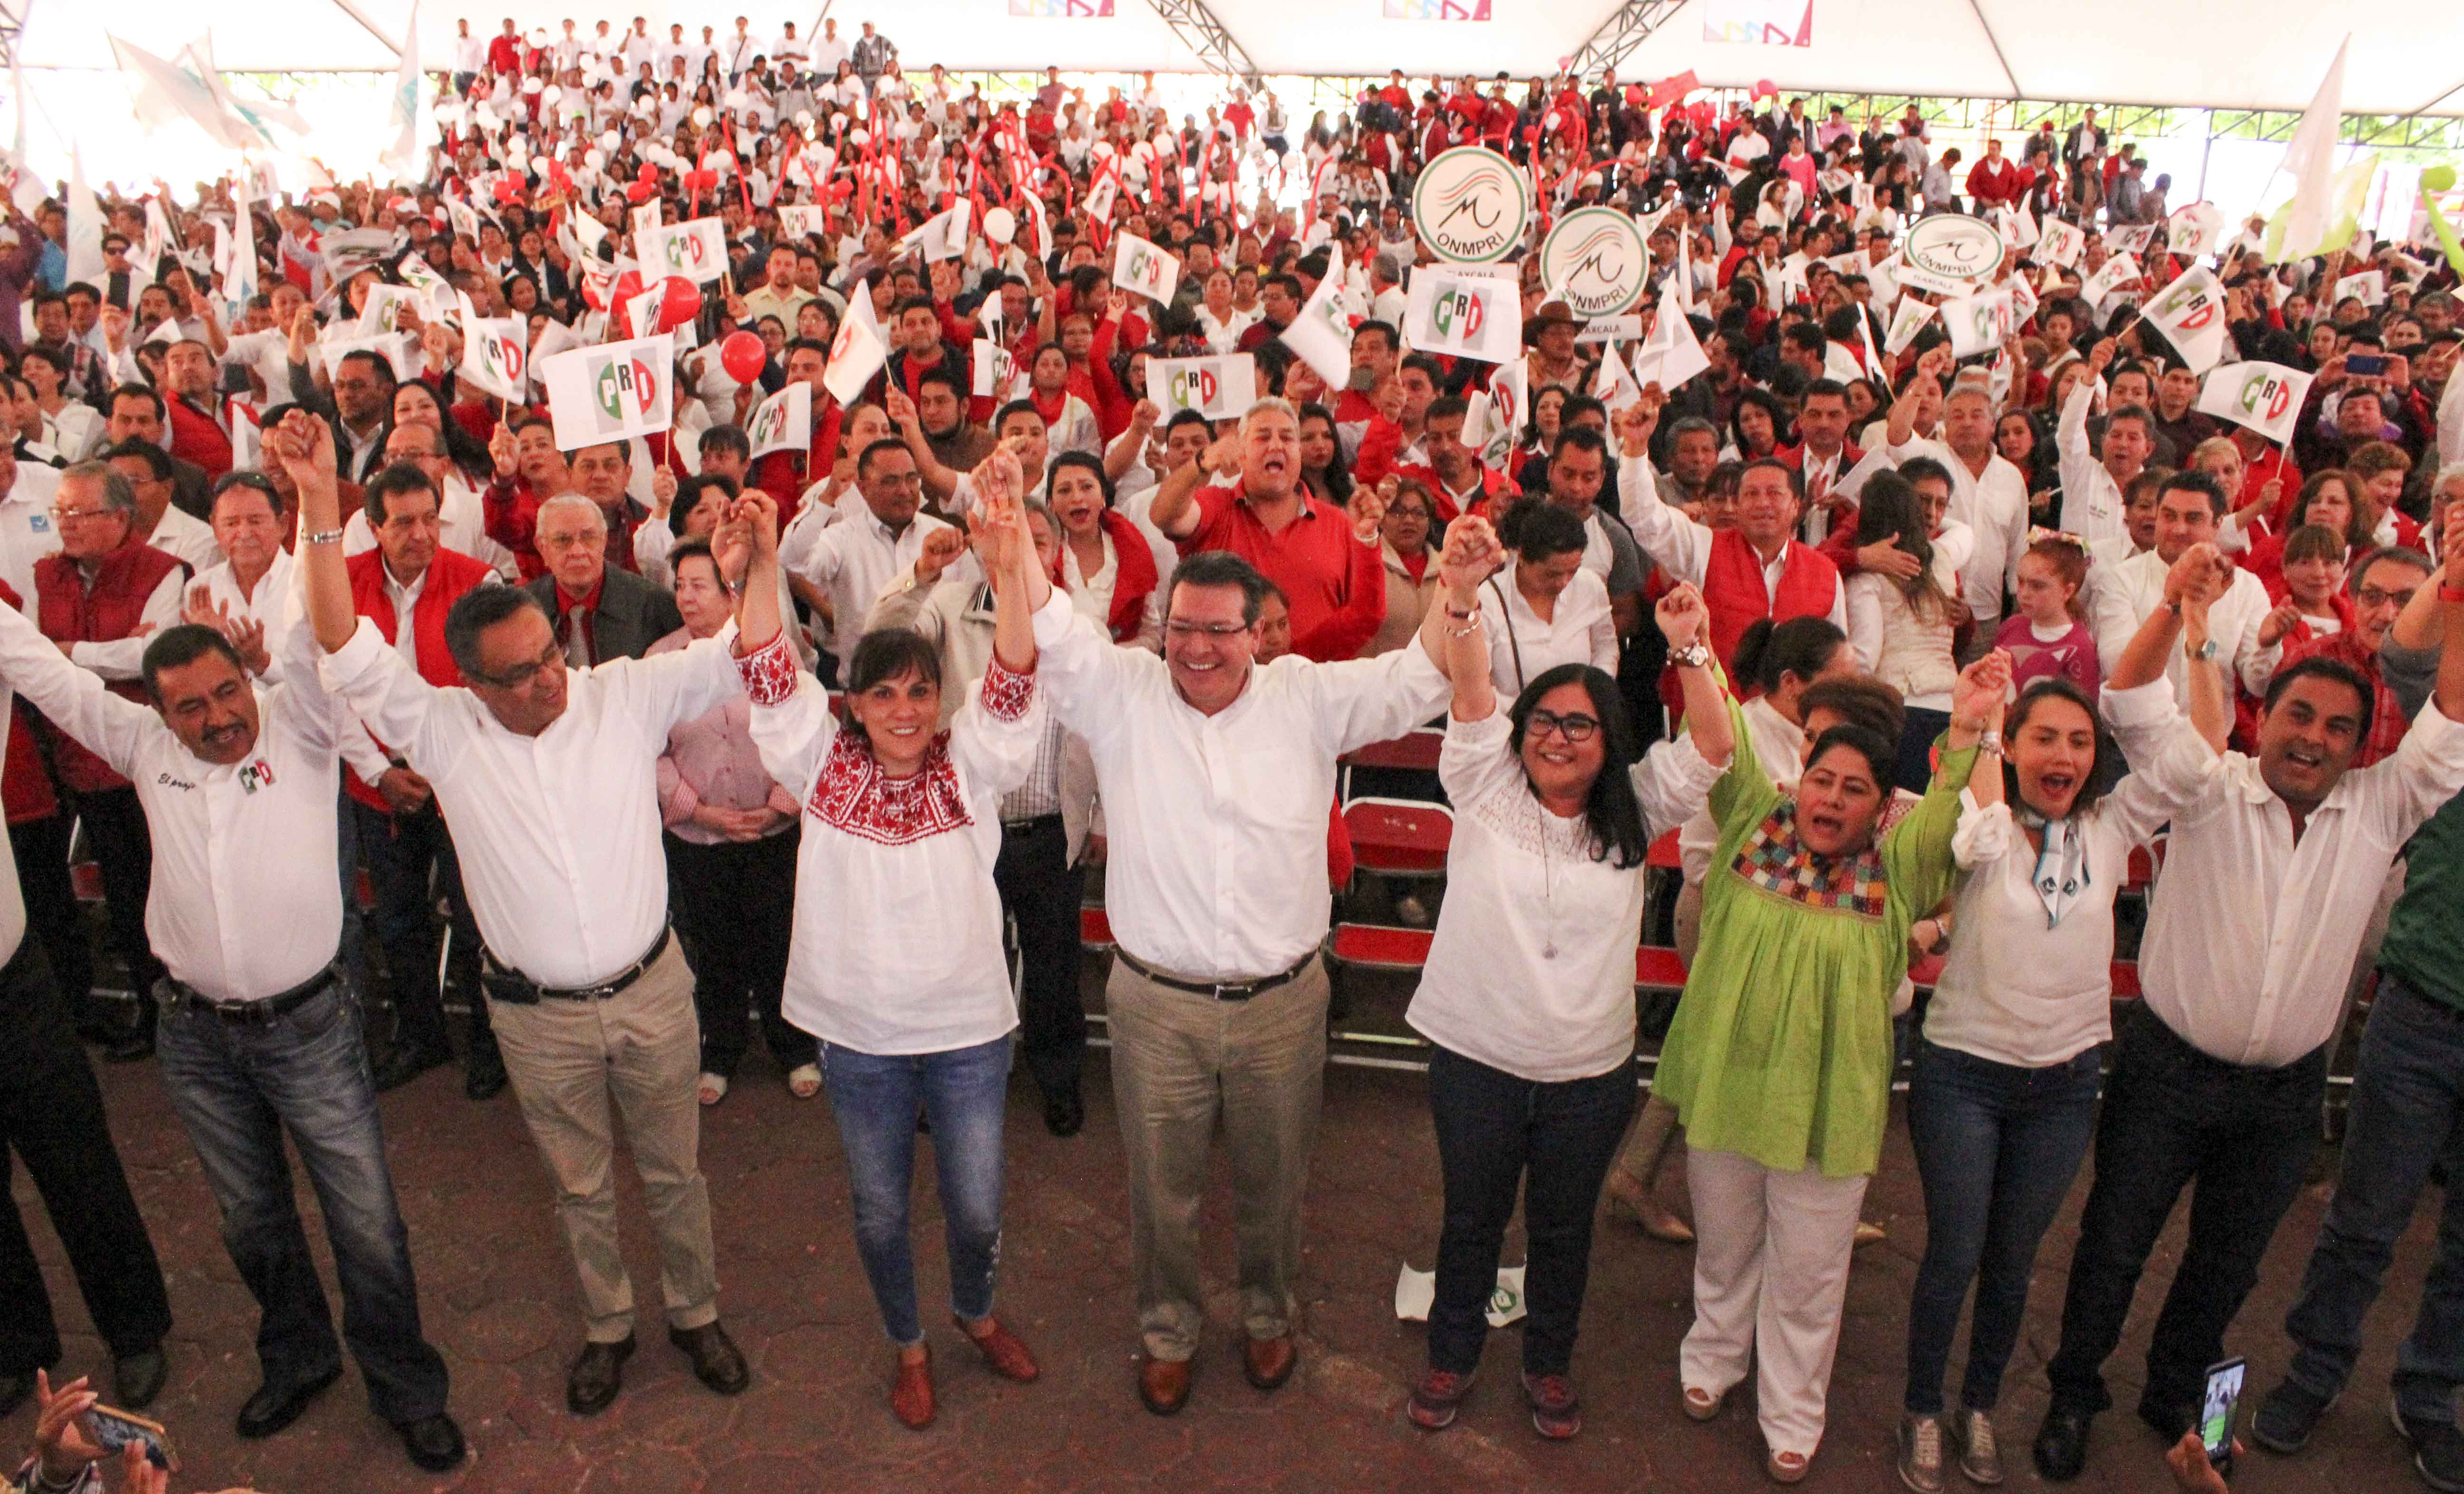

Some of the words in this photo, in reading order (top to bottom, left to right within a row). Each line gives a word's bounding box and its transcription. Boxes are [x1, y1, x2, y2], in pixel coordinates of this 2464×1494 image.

[1437, 231, 1504, 255] ONMPRI
[1437, 294, 1479, 330] PRI
[2171, 289, 2208, 326] PRI
[601, 364, 650, 407] PRI
[1175, 372, 1212, 400] PRI
[2243, 380, 2286, 413] PRI
[760, 408, 783, 437] PRI
[243, 766, 270, 787] PRI
